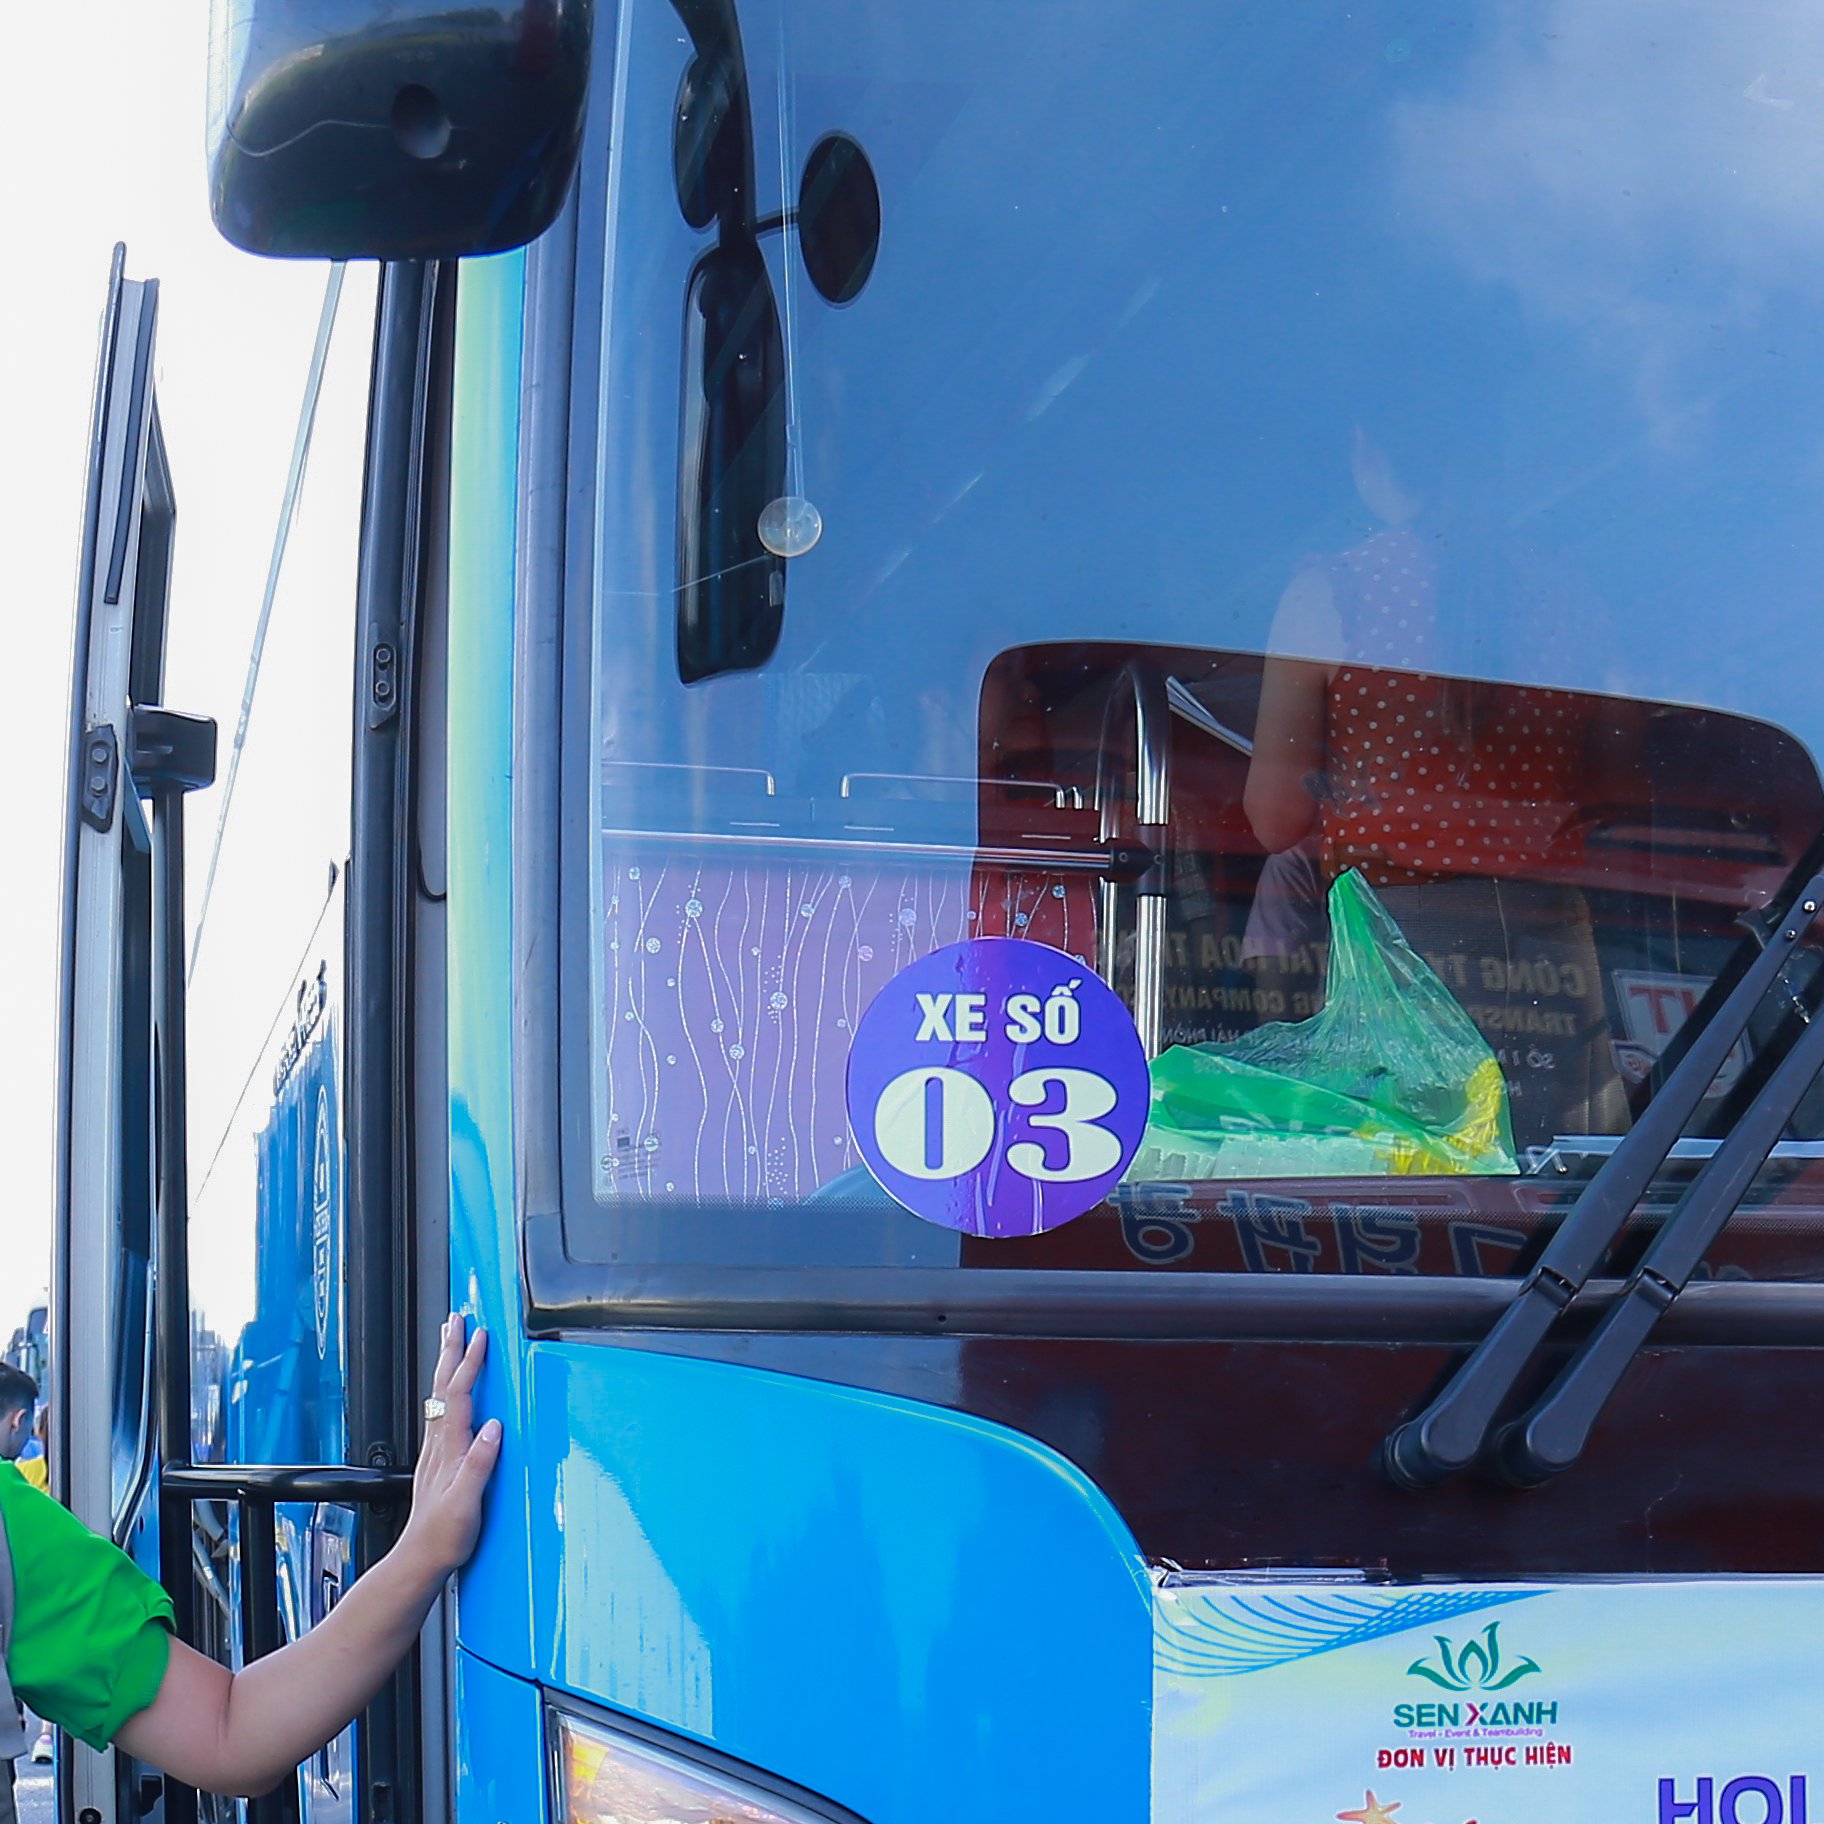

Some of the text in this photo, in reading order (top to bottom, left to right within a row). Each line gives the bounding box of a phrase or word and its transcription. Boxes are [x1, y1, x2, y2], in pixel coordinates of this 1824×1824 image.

[913, 976, 1082, 1047] XE SỐ
[873, 1064, 1126, 1185] 03
[1393, 1700, 1558, 1728] SEN XANH
[1408, 1729, 1437, 1740] Travel
[1482, 1727, 1544, 1738] Teambuilding
[1434, 1747, 1456, 1772] VỊ
[1463, 1745, 1517, 1772] THỰC
[1524, 1740, 1572, 1770] HIỆN
